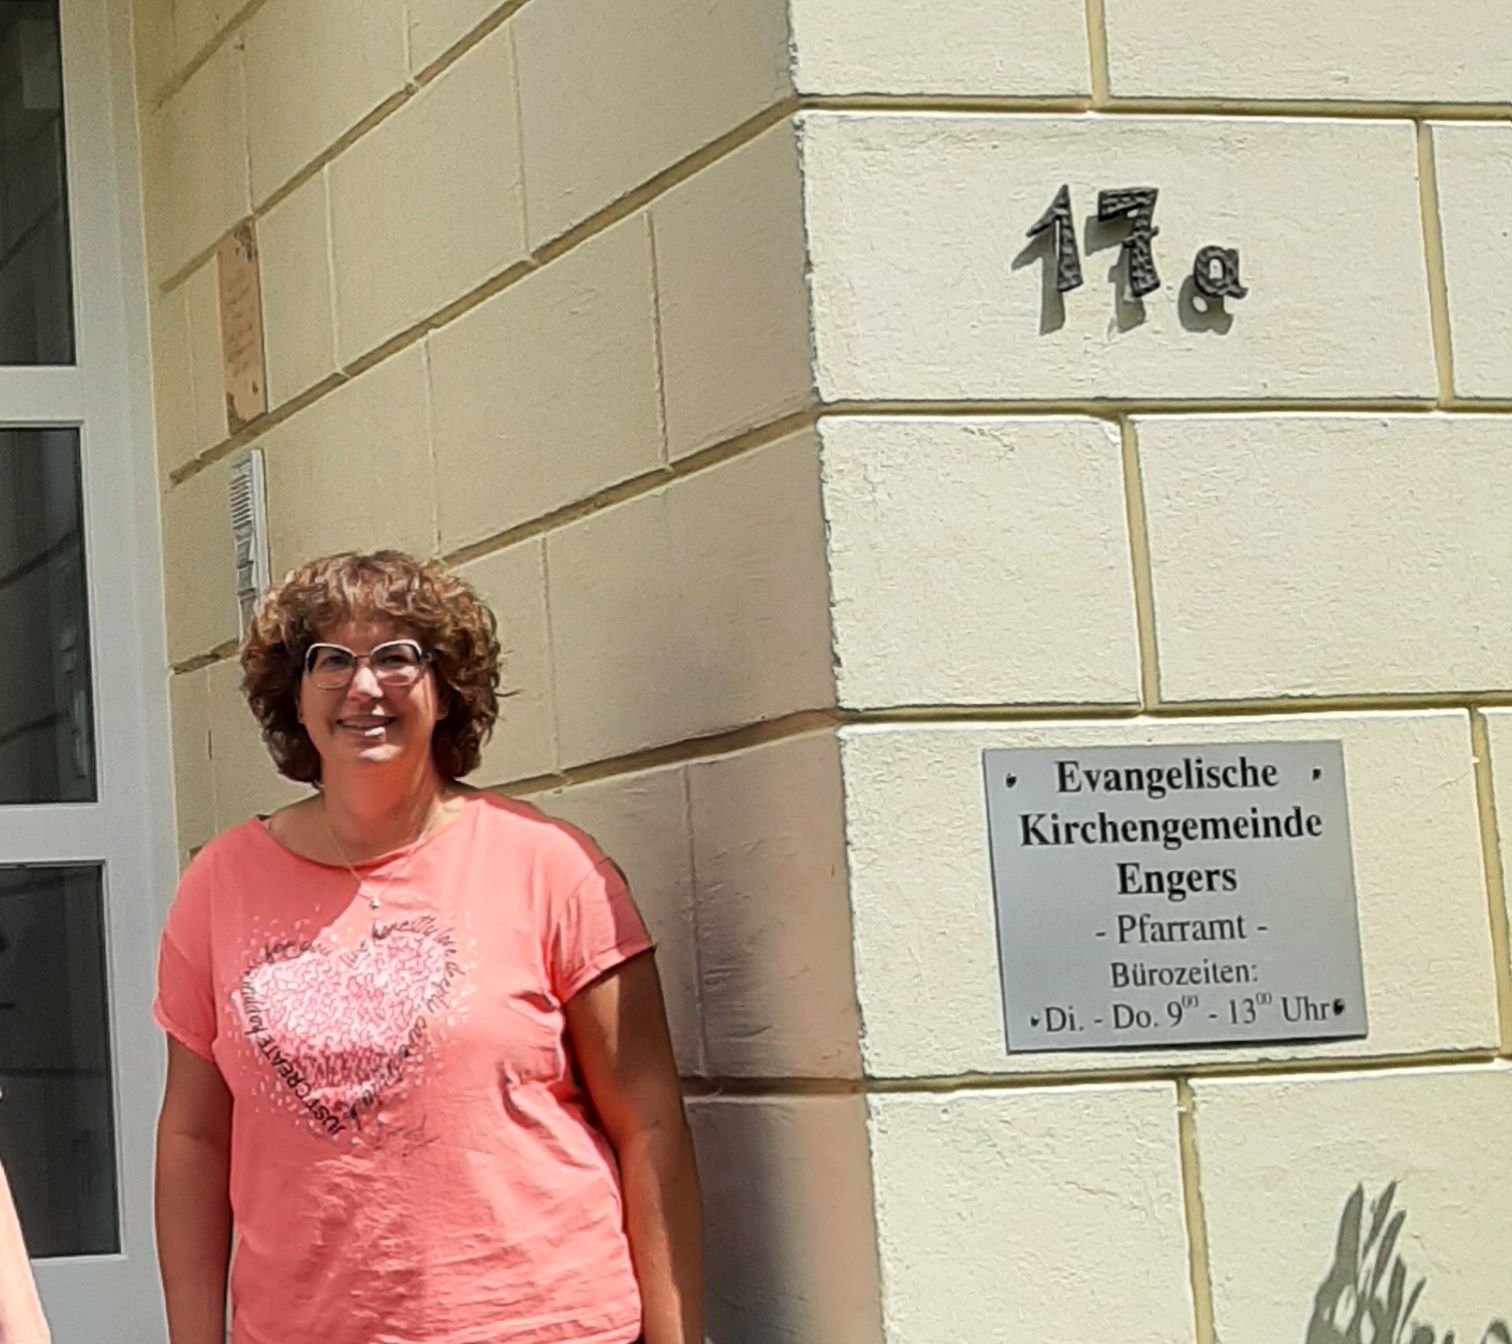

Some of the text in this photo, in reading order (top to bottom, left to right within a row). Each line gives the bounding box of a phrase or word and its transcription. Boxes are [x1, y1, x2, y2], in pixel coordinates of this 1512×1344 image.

[1055, 757, 1280, 799] Evangelische
[1019, 806, 1324, 850] Kirchengemeinde
[1116, 862, 1238, 902] Engers
[1117, 913, 1247, 945] Pfarramt
[1110, 959, 1260, 989] Bürozeiten:
[1044, 1006, 1086, 1033] Di.
[1112, 1003, 1159, 1030] Do.
[1282, 995, 1332, 1023] Uhr
[257, 1033, 313, 1100] CREATE
[305, 1098, 346, 1137] JUST
